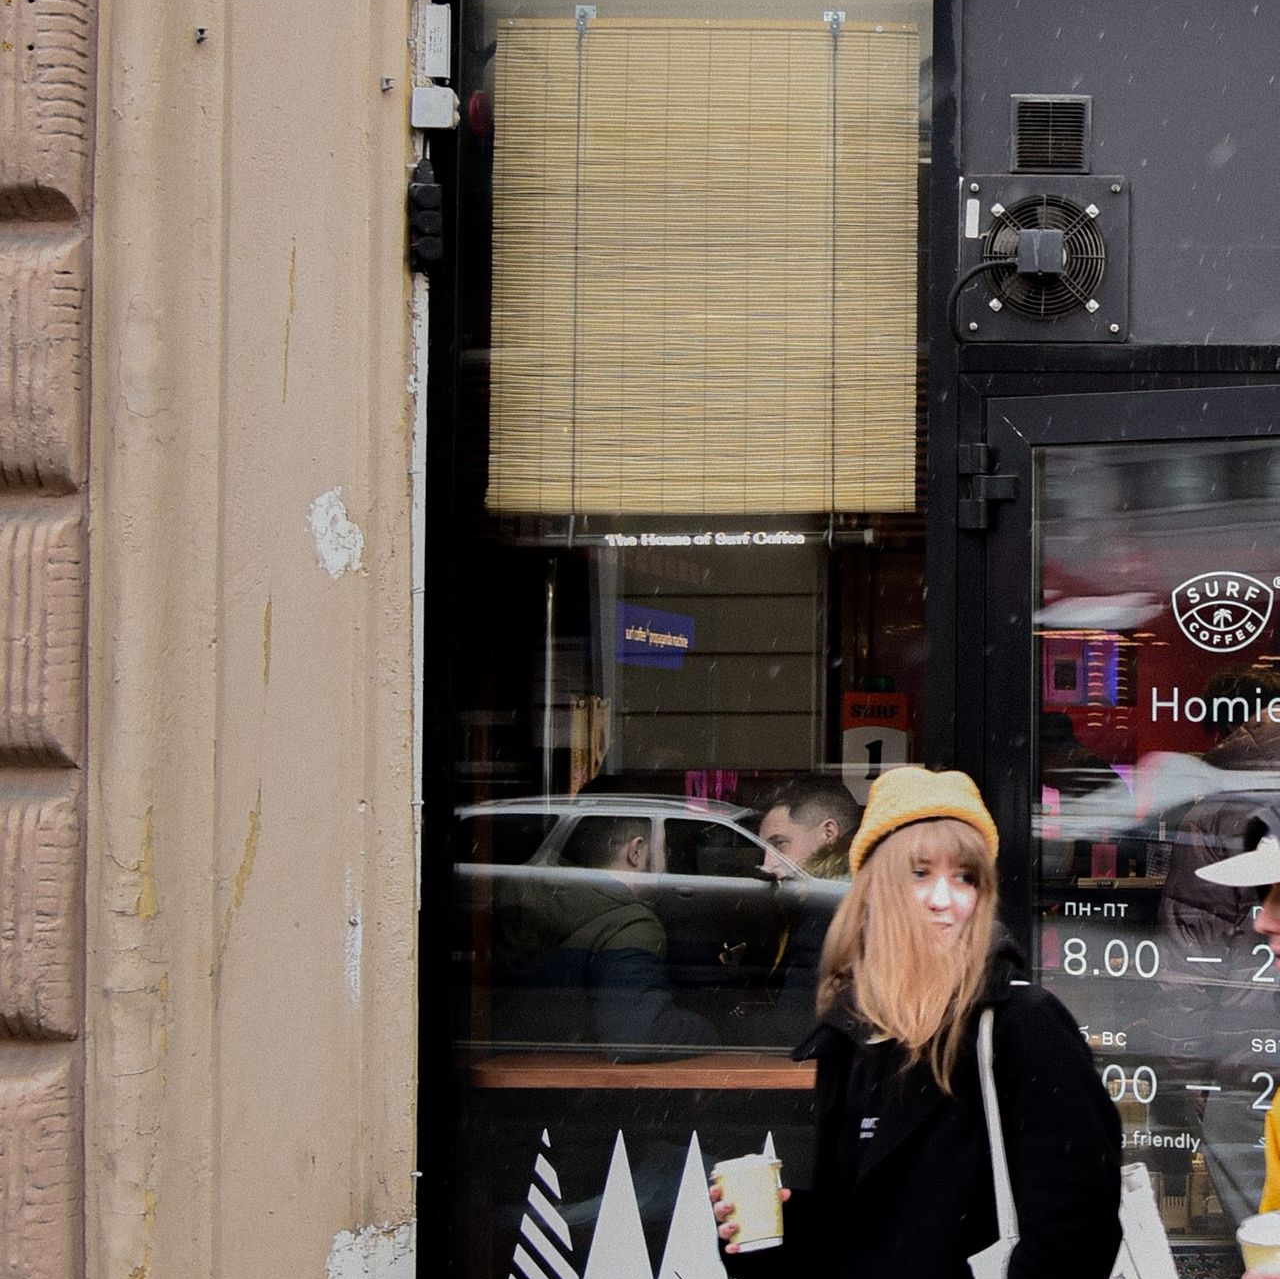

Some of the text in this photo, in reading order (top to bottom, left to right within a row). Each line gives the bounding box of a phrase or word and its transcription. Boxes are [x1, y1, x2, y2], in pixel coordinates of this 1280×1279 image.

[605, 534, 637, 546] The
[693, 532, 712, 545] of
[715, 532, 750, 545] Surf
[753, 531, 806, 545] Coffee
[1186, 580, 1260, 603] SURF
[1189, 621, 1256, 645] COFFEE
[850, 703, 902, 719] SURF
[1064, 937, 1160, 978] 8.00
[1102, 1064, 1158, 1104] 00
[1133, 1131, 1201, 1153] friendly
